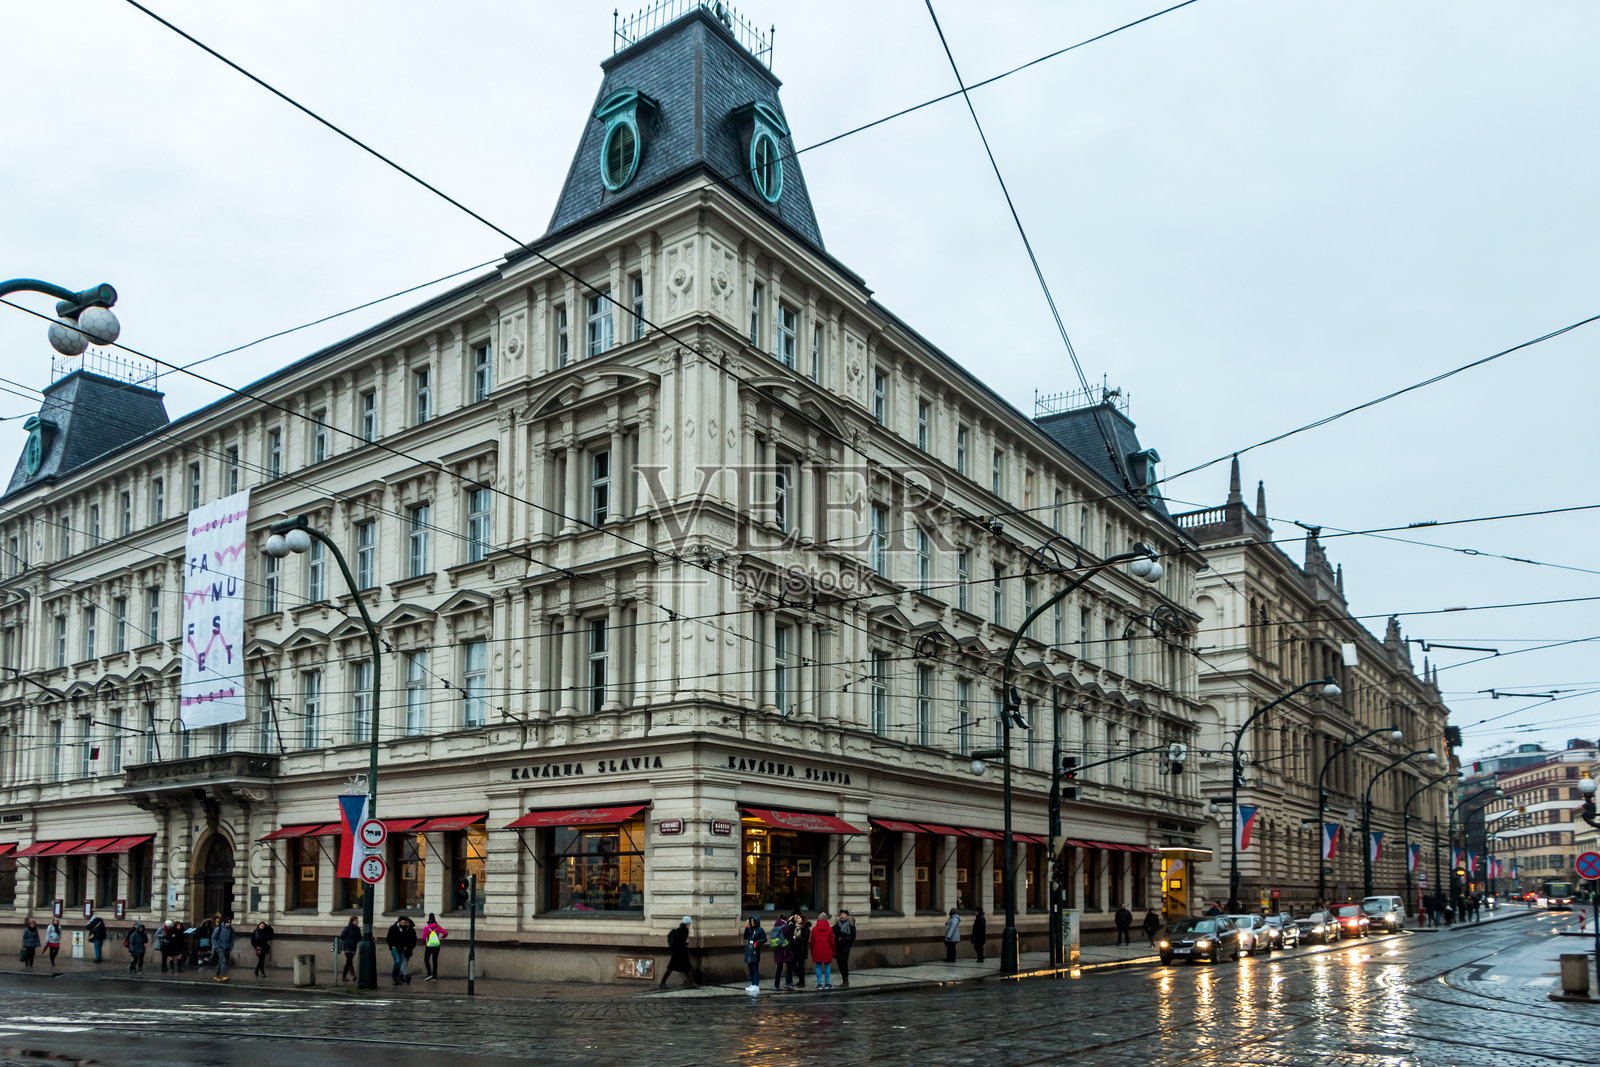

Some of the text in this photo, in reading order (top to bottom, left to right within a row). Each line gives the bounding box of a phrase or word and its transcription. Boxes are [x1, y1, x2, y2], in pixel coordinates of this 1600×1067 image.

[511, 756, 663, 780] KAVÁRNA SLAVIA
[728, 756, 851, 785] KAVÁRNA SLAVIA
